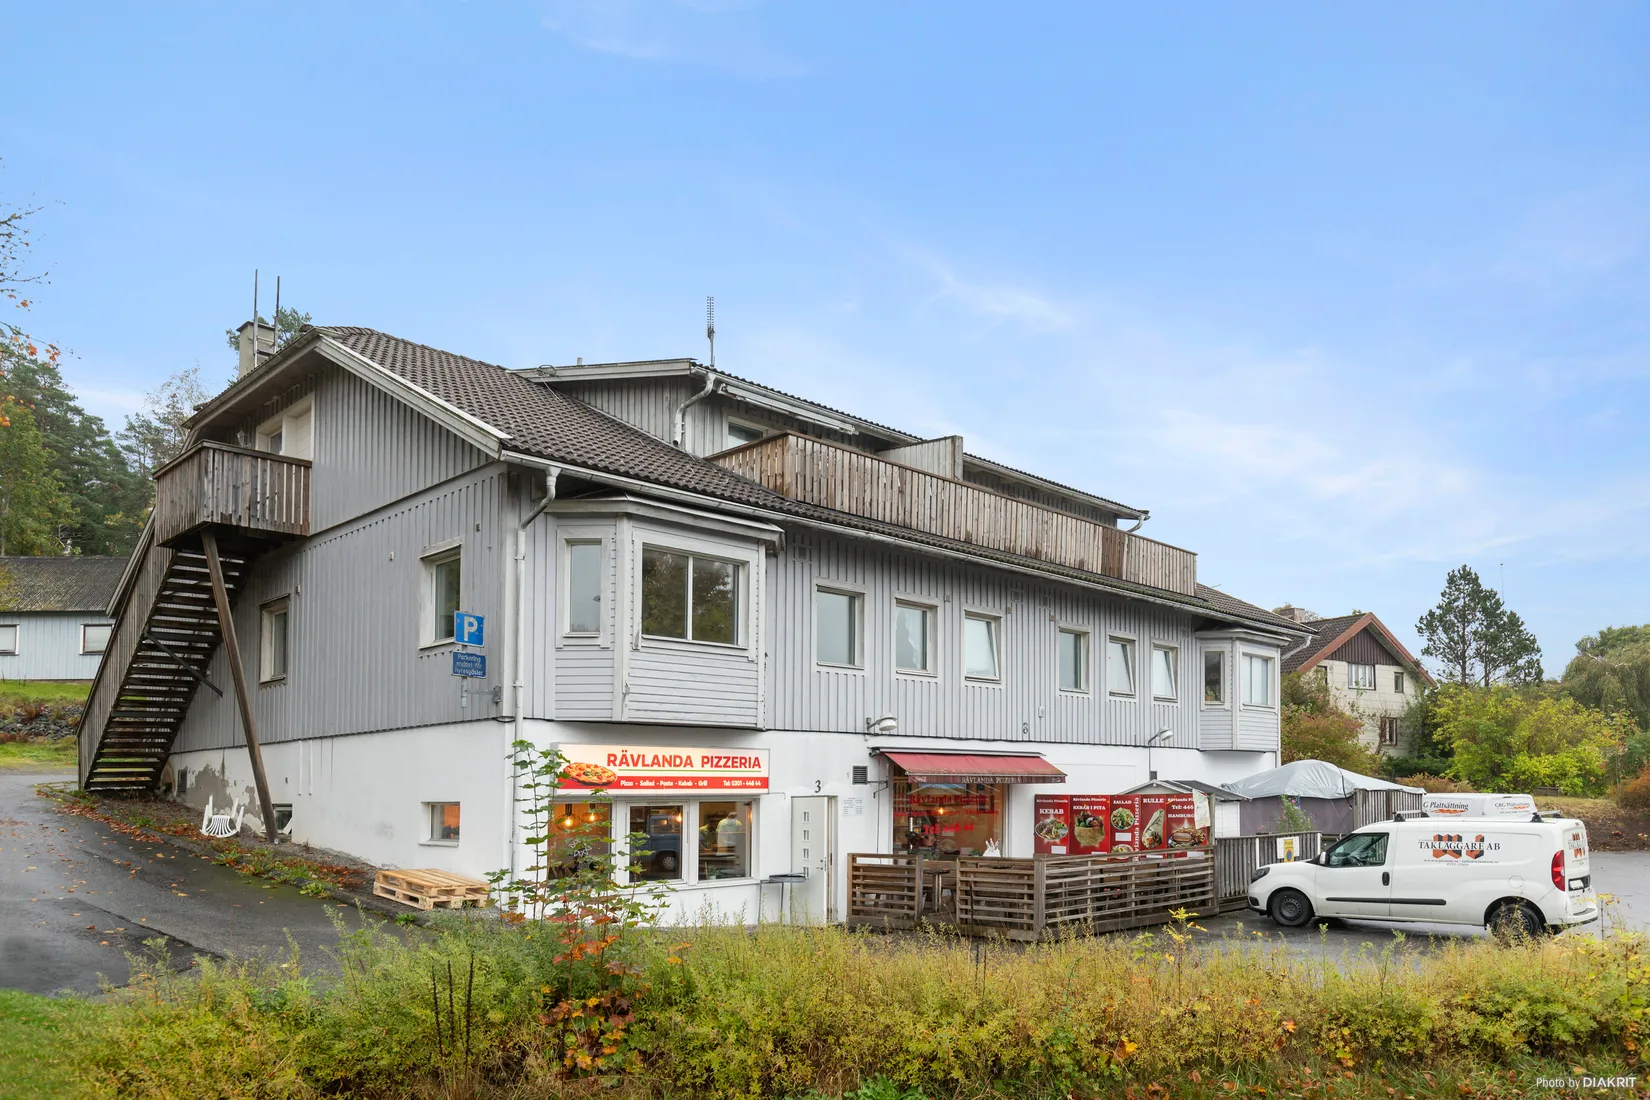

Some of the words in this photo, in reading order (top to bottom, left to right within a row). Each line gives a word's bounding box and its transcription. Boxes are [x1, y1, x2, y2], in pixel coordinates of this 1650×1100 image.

[463, 616, 478, 642] P
[455, 660, 473, 669] endast
[607, 749, 694, 768] RÄVLANDA
[701, 755, 761, 769] PIZZERIA
[814, 779, 822, 794] 3
[1430, 801, 1469, 811] Plattsättning
[1486, 842, 1501, 851] AB
